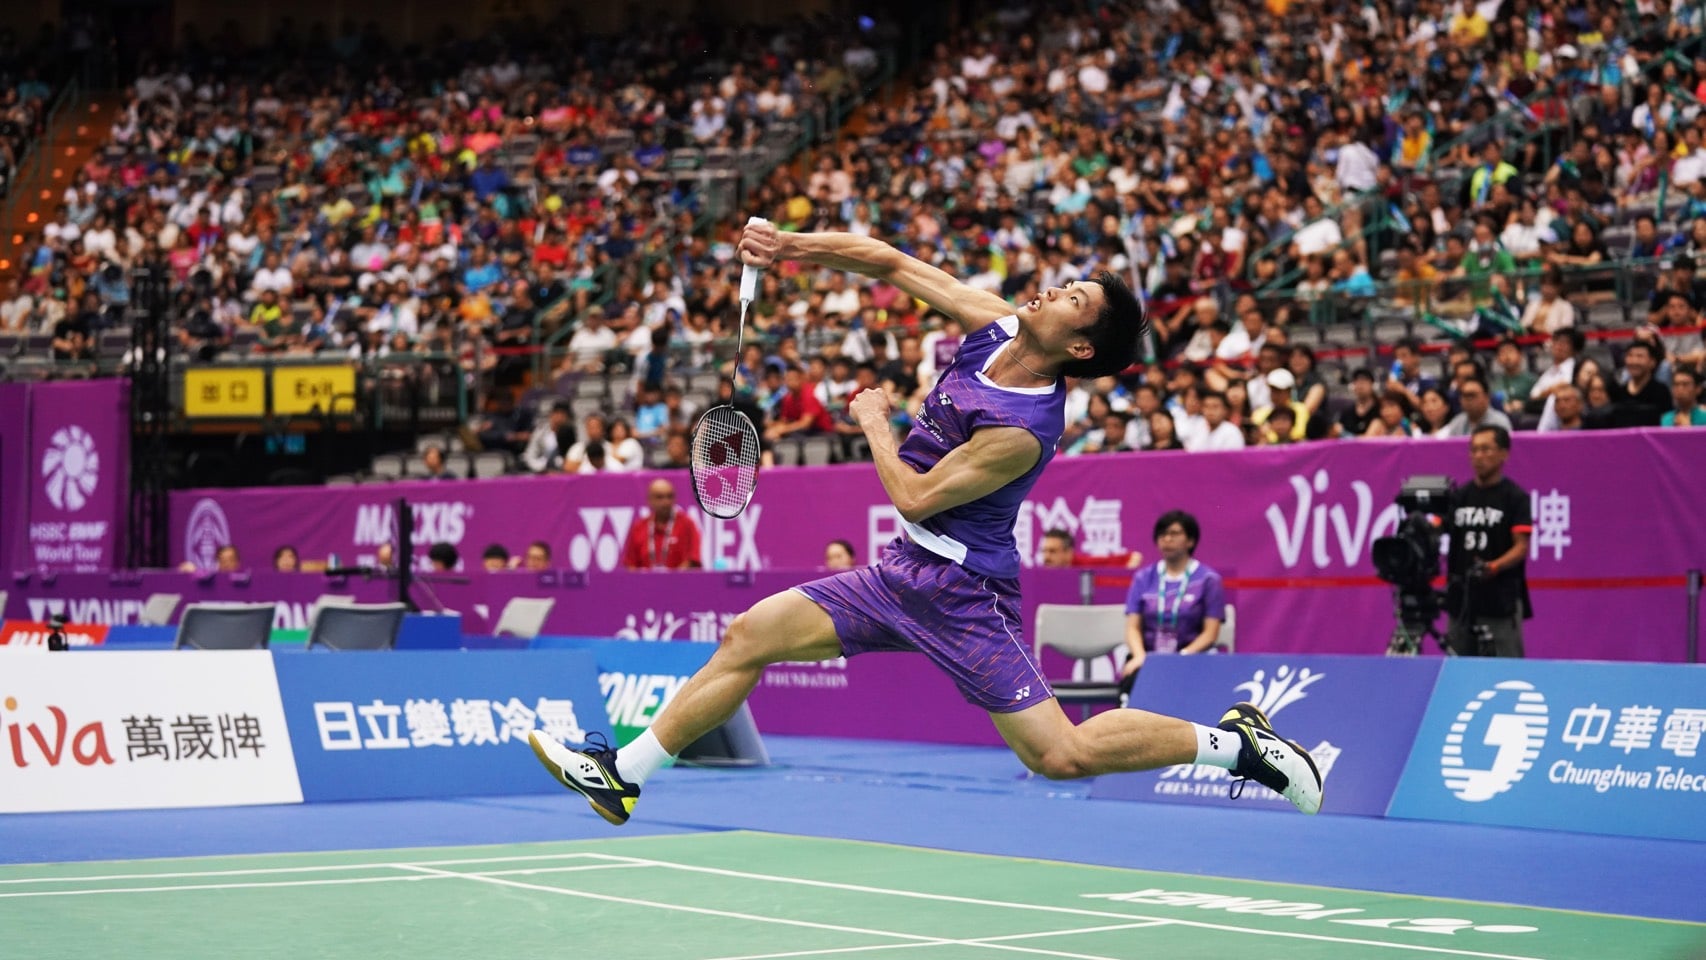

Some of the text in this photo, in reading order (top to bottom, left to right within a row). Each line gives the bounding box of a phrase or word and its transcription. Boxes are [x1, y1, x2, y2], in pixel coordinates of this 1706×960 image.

[0, 696, 266, 768] iva 萬歲牌
[313, 697, 586, 751] 日立變頻冷氣
[1548, 759, 1651, 793] Chunghwa
